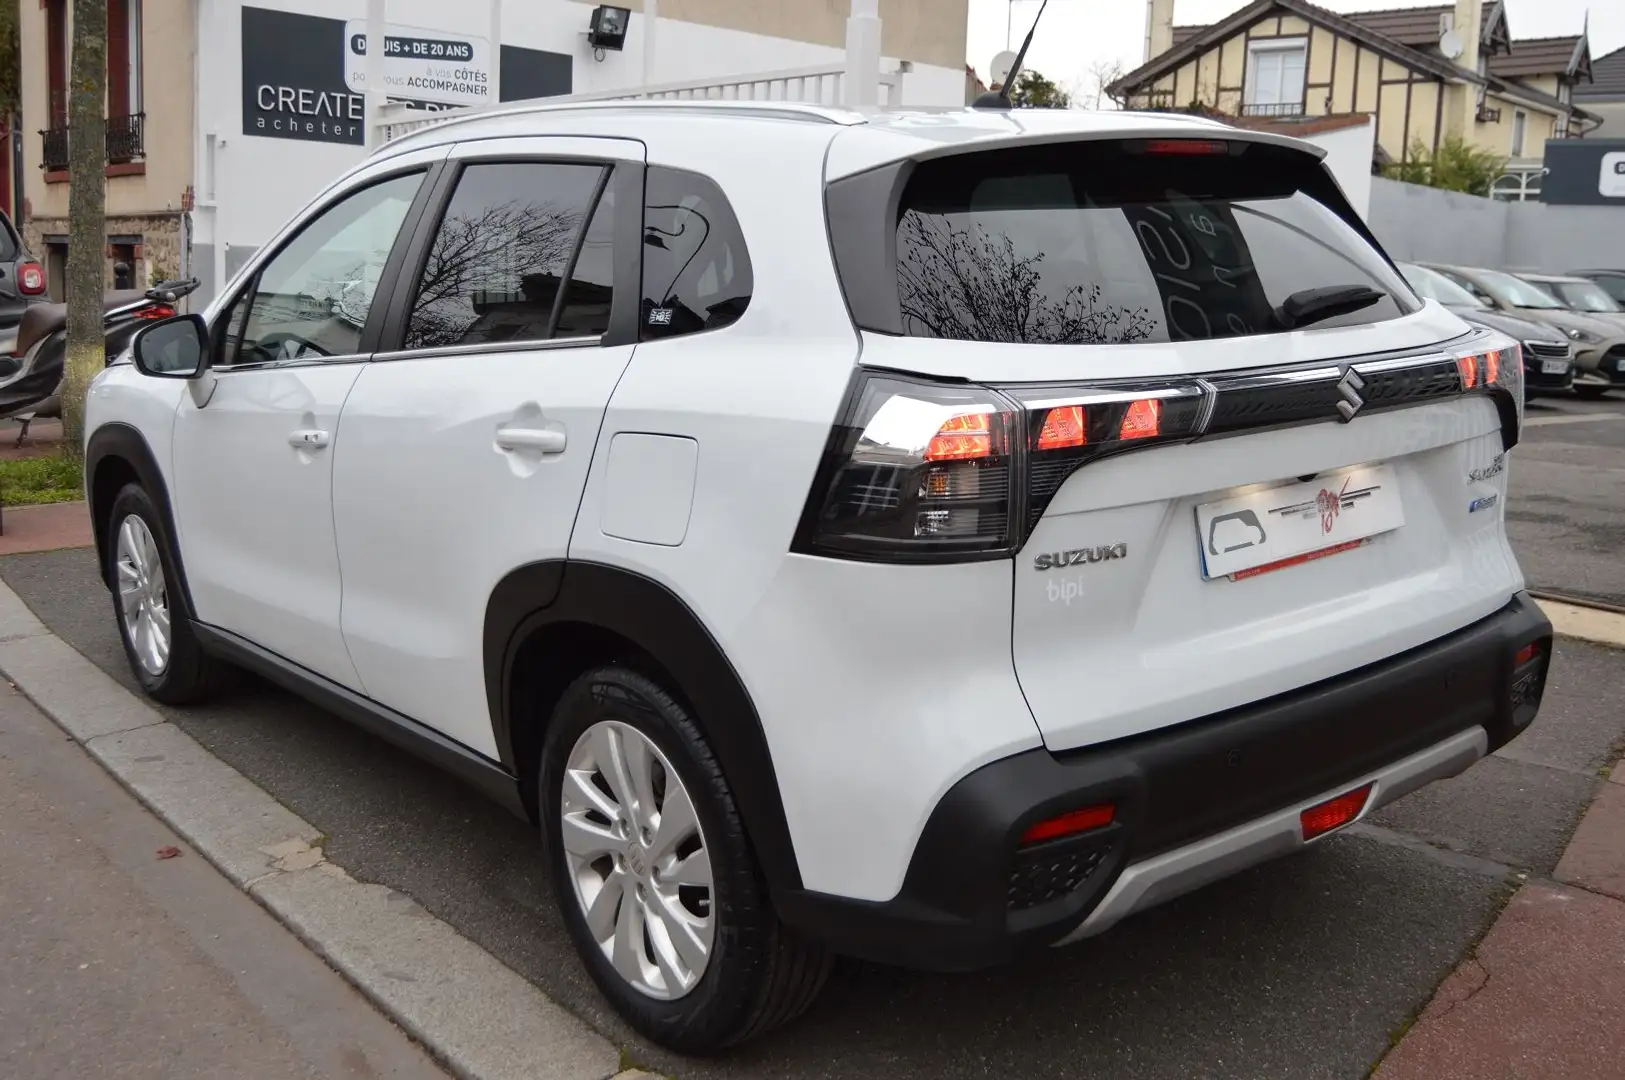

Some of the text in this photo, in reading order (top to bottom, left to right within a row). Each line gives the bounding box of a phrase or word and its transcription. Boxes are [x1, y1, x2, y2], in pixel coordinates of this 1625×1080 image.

[358, 38, 401, 53] DUIS
[412, 42, 428, 55] DE
[430, 44, 444, 56] 20
[446, 45, 469, 57] ANS
[454, 67, 487, 83] CÔTÉS
[407, 76, 488, 96] ACCOMPAGNER
[257, 117, 356, 137] acheter
[1033, 542, 1128, 572] SUZUKI
[1045, 574, 1084, 606] bipi
